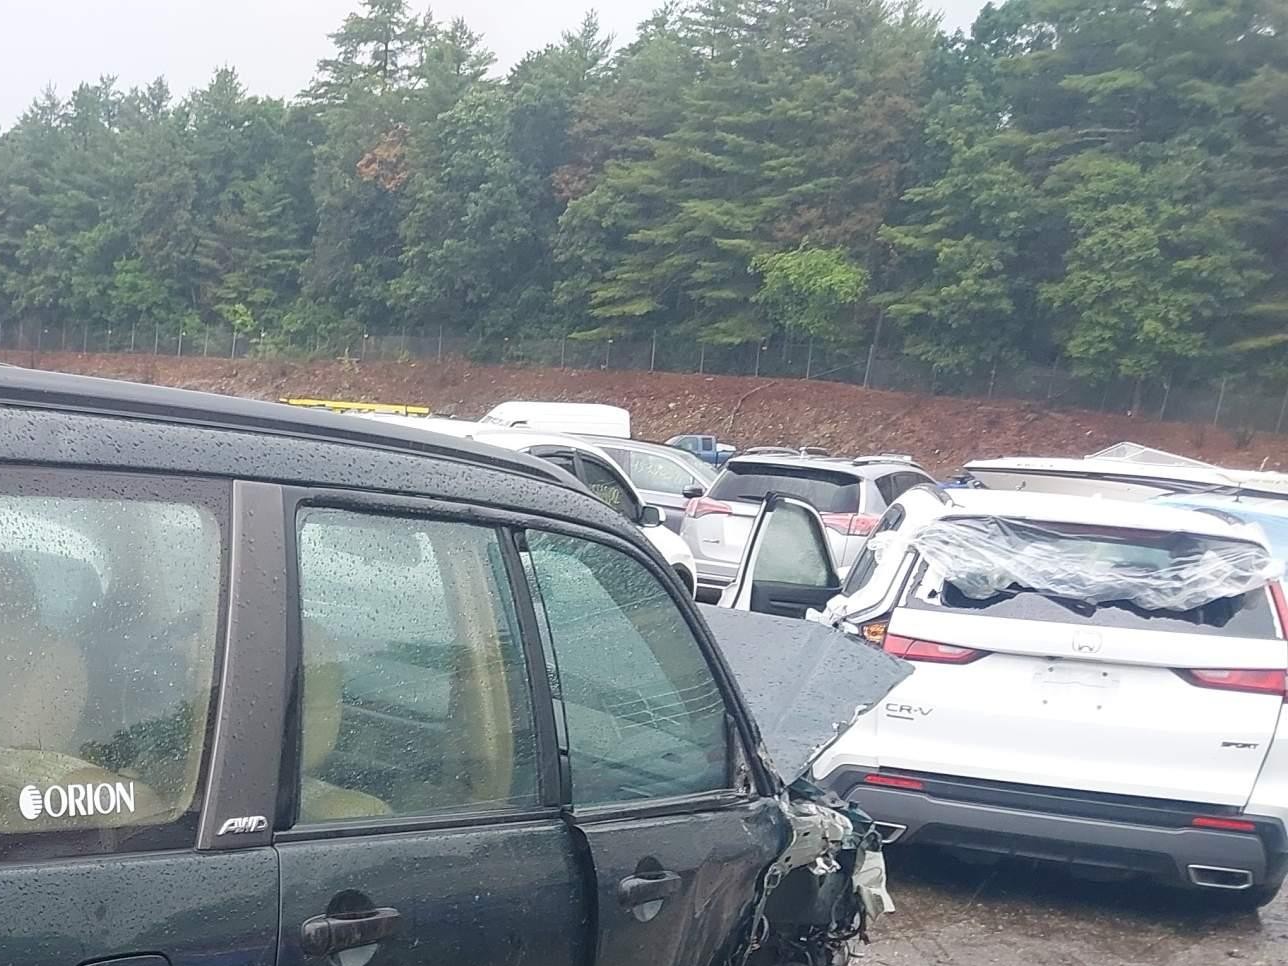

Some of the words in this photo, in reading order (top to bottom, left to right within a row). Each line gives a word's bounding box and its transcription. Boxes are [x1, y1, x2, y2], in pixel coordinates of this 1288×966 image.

[886, 703, 934, 715] CR-V
[43, 782, 136, 818] ORION
[216, 815, 269, 836] AWD
